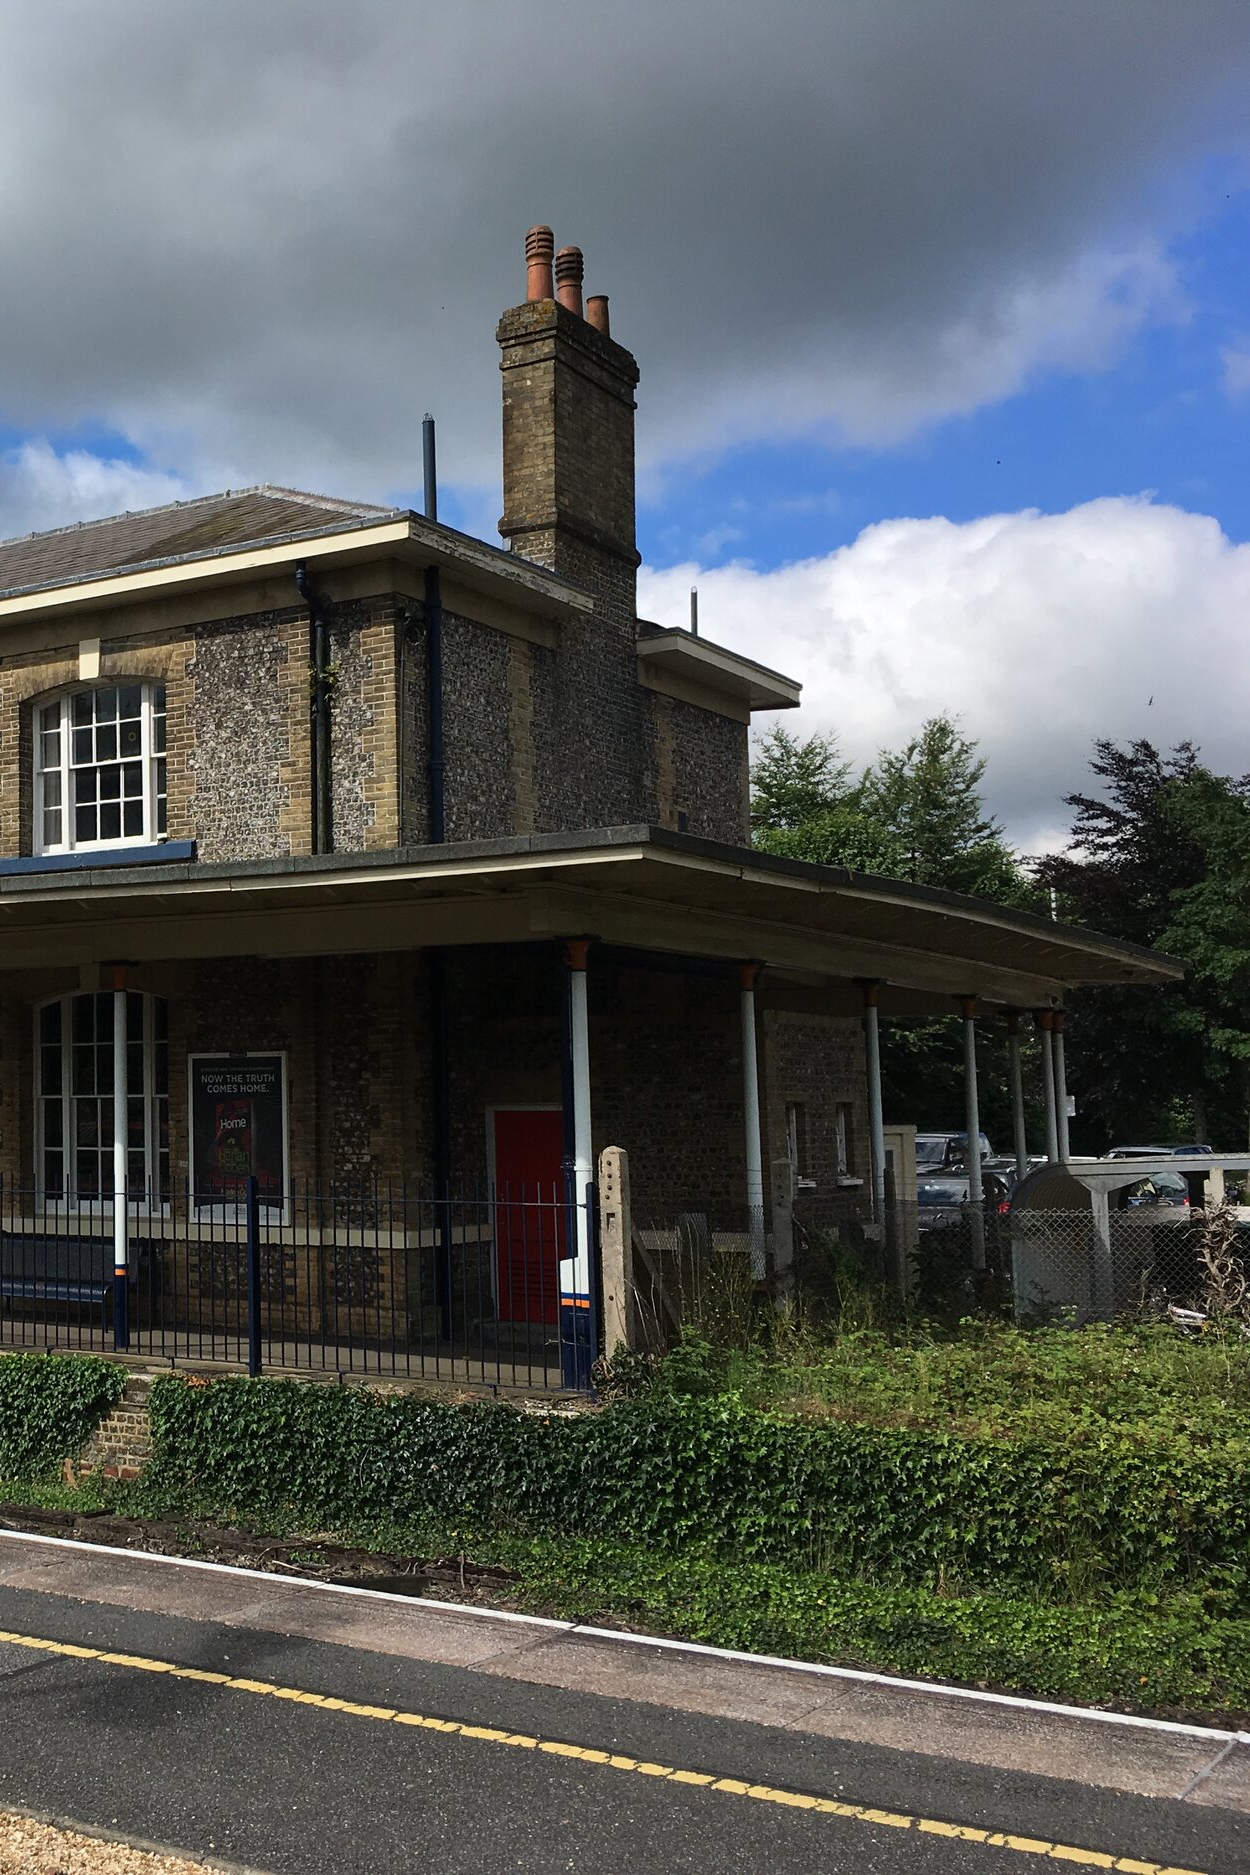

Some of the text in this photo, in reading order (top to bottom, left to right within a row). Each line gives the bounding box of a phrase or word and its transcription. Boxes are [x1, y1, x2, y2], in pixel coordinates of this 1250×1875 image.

[201, 1073, 275, 1083] NOW THE TRUTH
[206, 1084, 270, 1093] COMES HOME.
[220, 1117, 247, 1130] Home
